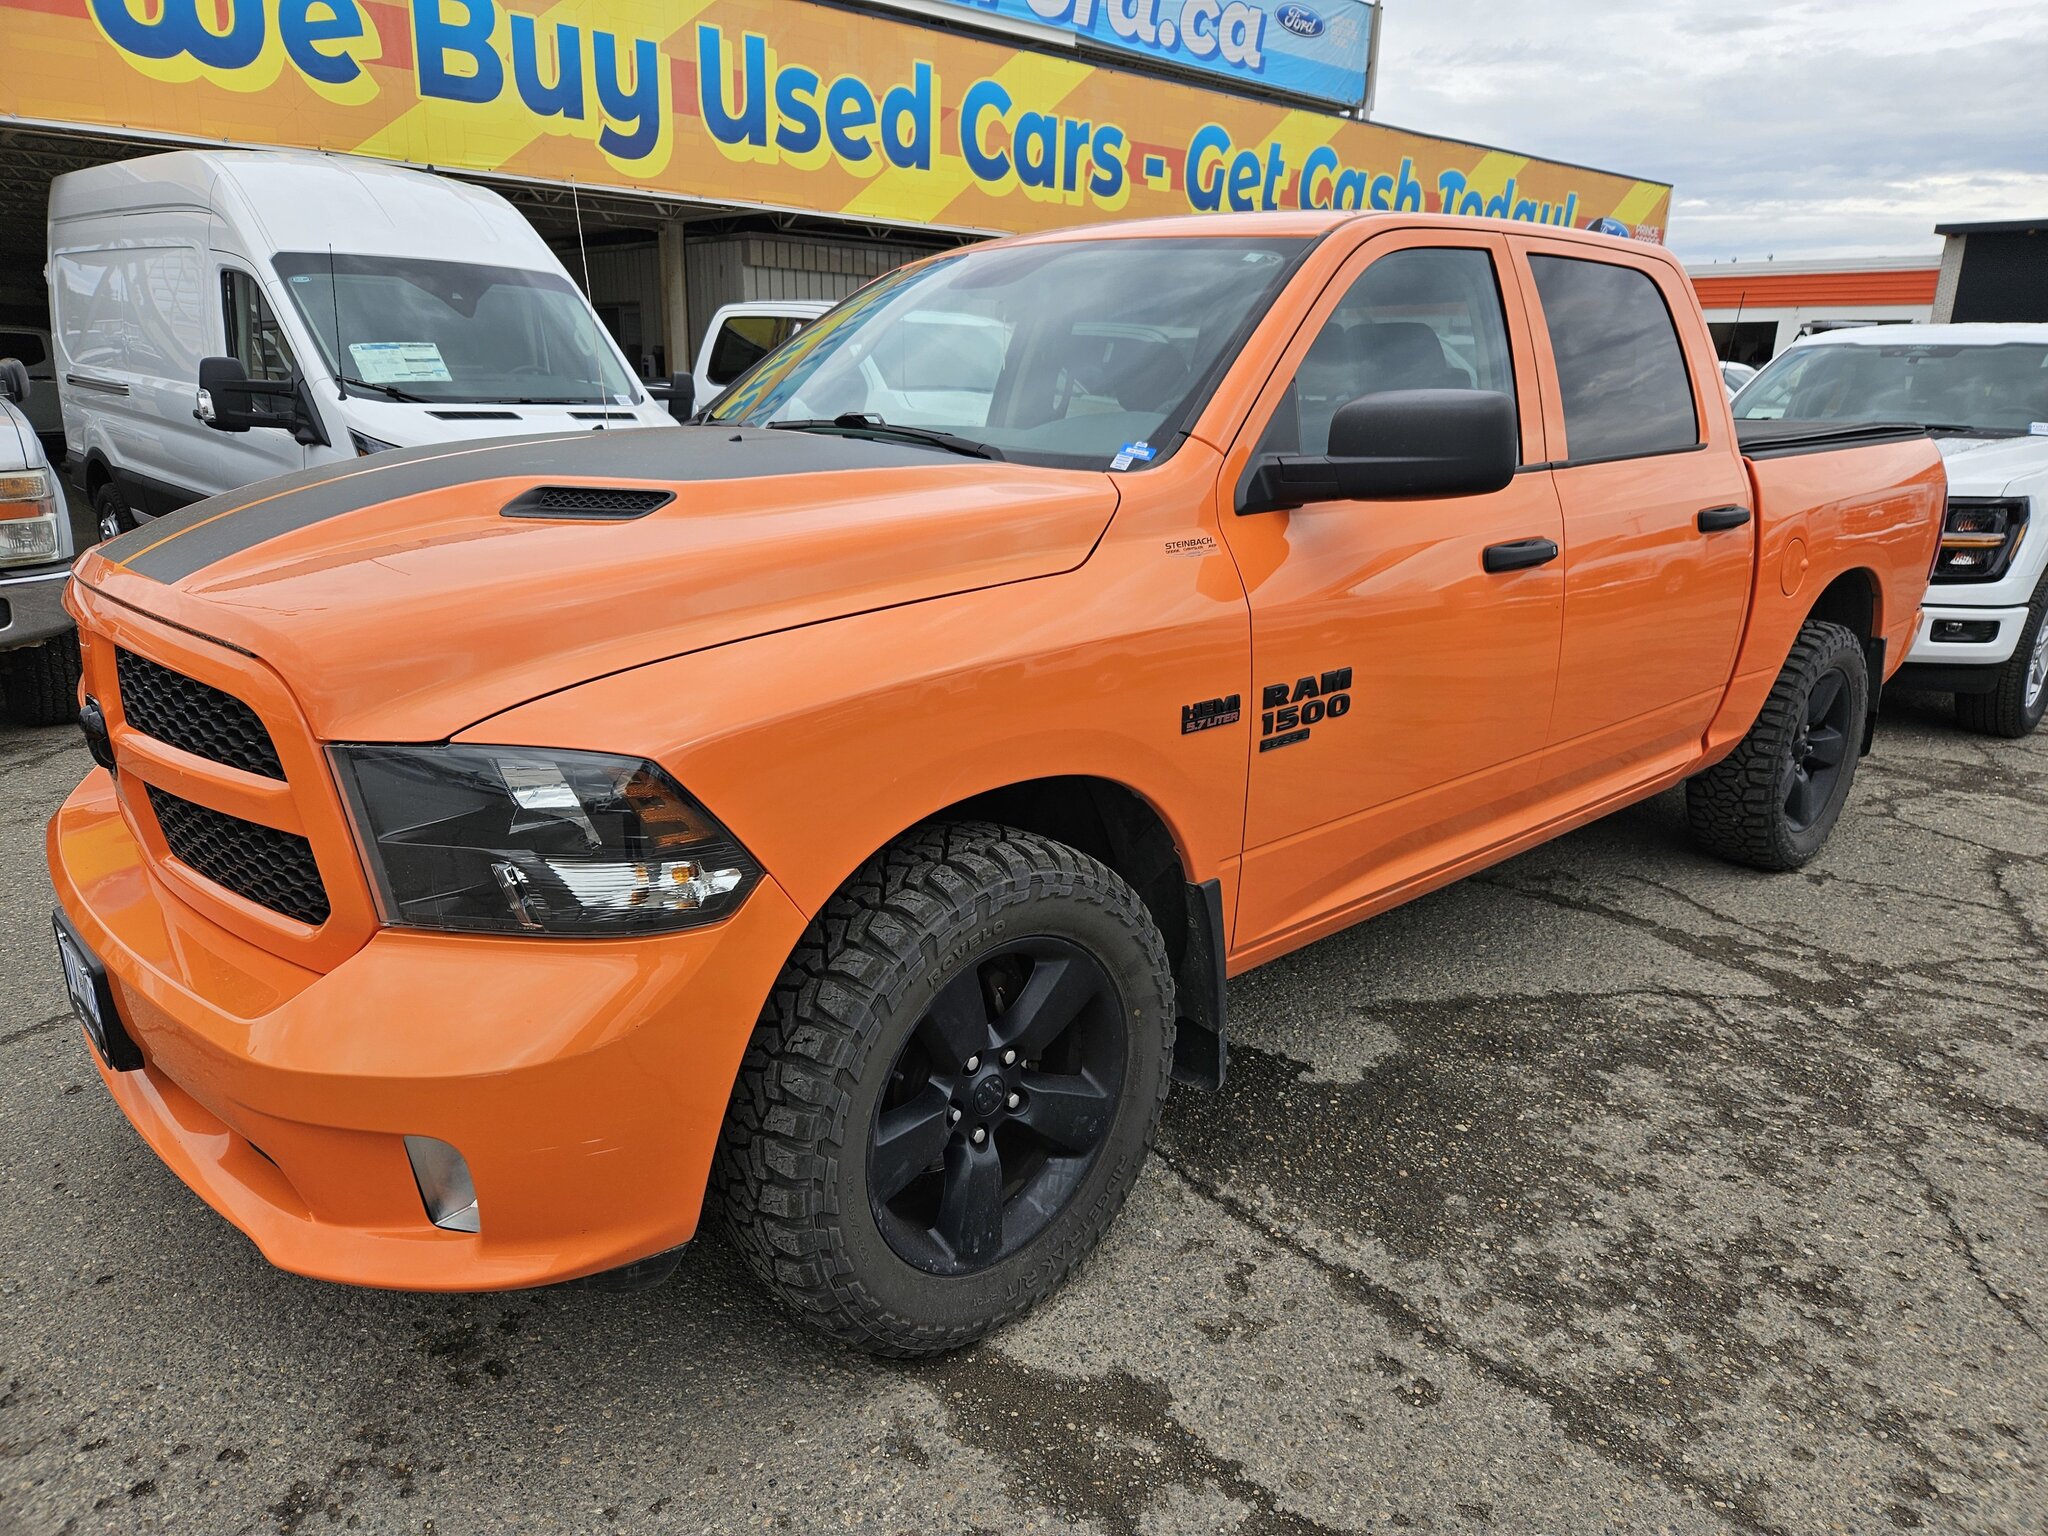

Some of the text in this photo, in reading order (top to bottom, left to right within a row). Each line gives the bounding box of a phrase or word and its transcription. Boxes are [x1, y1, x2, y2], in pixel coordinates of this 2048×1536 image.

[1284, 7, 1317, 34] Ford
[412, 0, 660, 160] Buy
[698, 26, 931, 170] Used
[959, 81, 1124, 197] Cars
[1185, 124, 1285, 212] Get
[1300, 146, 1421, 212] Cash
[1165, 537, 1213, 550] STEINBACH
[1262, 666, 1352, 710] RAM
[1182, 694, 1240, 723] HEMI
[1186, 711, 1240, 733] 5.7 LITER
[1262, 693, 1351, 736] 1500
[927, 919, 1006, 988] ROVELO
[1005, 1268, 1039, 1302] R/T
